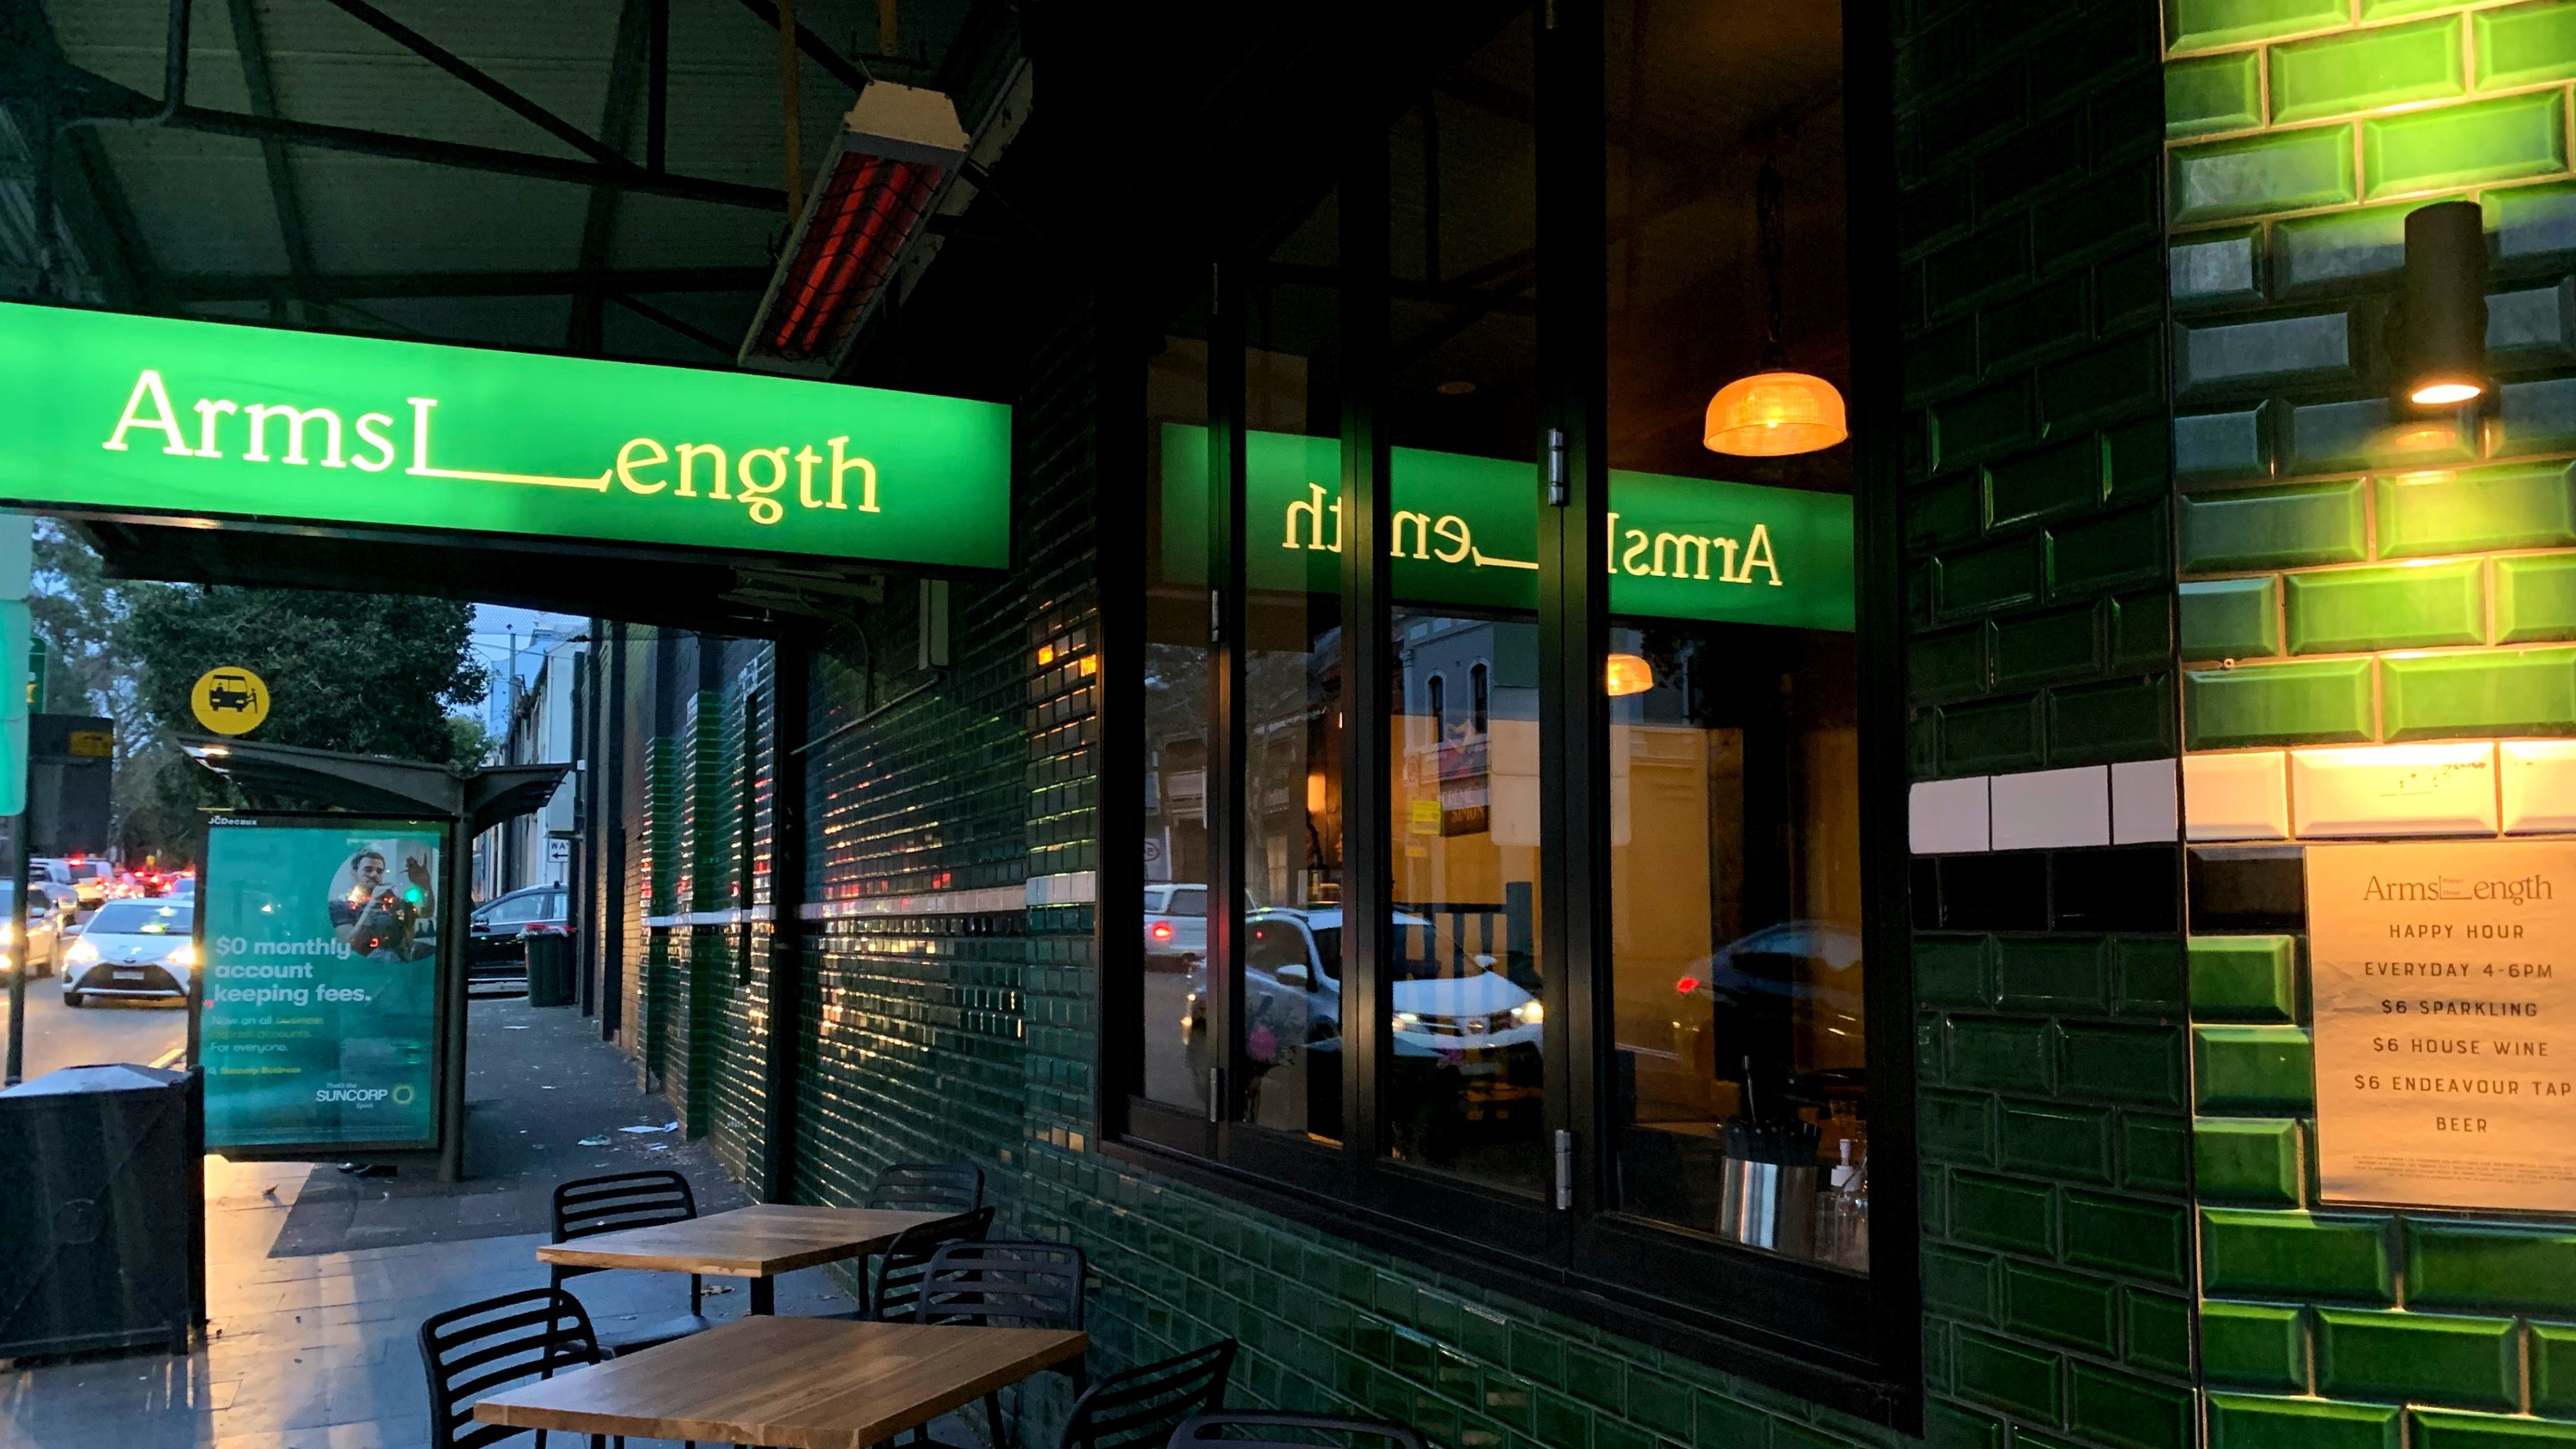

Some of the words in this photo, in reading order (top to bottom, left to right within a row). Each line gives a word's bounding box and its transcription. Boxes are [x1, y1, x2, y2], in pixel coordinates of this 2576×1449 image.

[208, 815, 257, 825] JCDecaux
[2390, 925, 2453, 938] HAPPY
[2467, 925, 2524, 938] HOUR
[216, 936, 246, 956] $0
[253, 937, 352, 960] monthly
[215, 962, 313, 979] account
[2365, 962, 2470, 977] EVERYDAY
[2483, 964, 2552, 979] 4-6PM
[214, 984, 308, 1006] keeping
[316, 984, 371, 1002] fees.
[2381, 999, 2407, 1014] $6
[2420, 1001, 2537, 1016] SPARKLING
[240, 1016, 257, 1026] on
[258, 1015, 272, 1025] all
[210, 1041, 229, 1052] For
[233, 1043, 289, 1053] everyone.
[2373, 1037, 2398, 1052] $6
[2411, 1039, 2480, 1055] HOUSE
[2494, 1041, 2549, 1057] WINE
[2354, 1075, 2379, 1089] $6
[2393, 1076, 2518, 1094] ENDEAVOUR
[2532, 1082, 2571, 1096] TAP
[316, 1089, 388, 1102] SUNCORP
[2437, 1117, 2487, 1132] BEER
